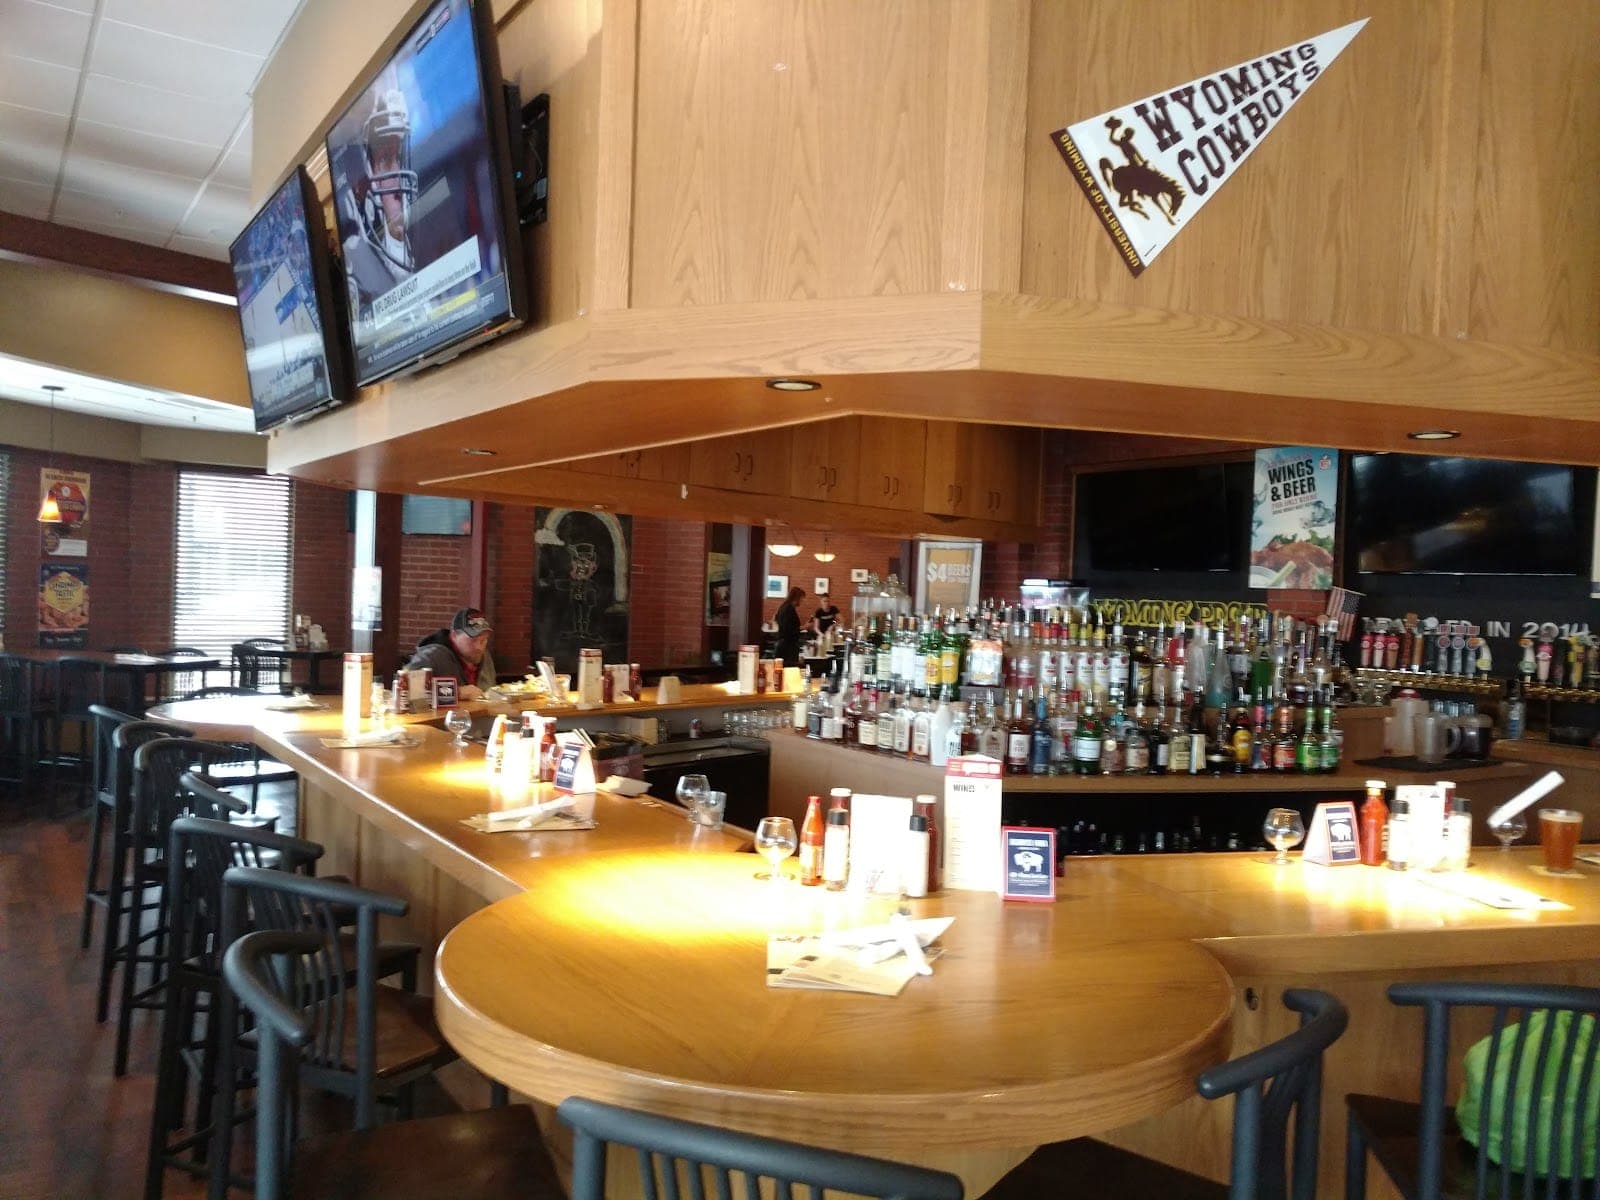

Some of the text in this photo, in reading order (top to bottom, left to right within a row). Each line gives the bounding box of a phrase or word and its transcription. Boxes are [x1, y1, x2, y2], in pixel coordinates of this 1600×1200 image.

[1134, 43, 1317, 152] WYOMING
[1177, 61, 1320, 196] COWBOYS
[1060, 134, 1140, 267] UNIVERSITY OF WYOMING
[1268, 459, 1315, 485] WINGS
[1271, 486, 1282, 502] &
[1283, 476, 1316, 499] BEER
[927, 562, 947, 582] $4
[1487, 620, 1511, 638] IN
[1521, 621, 1592, 642] 2014
